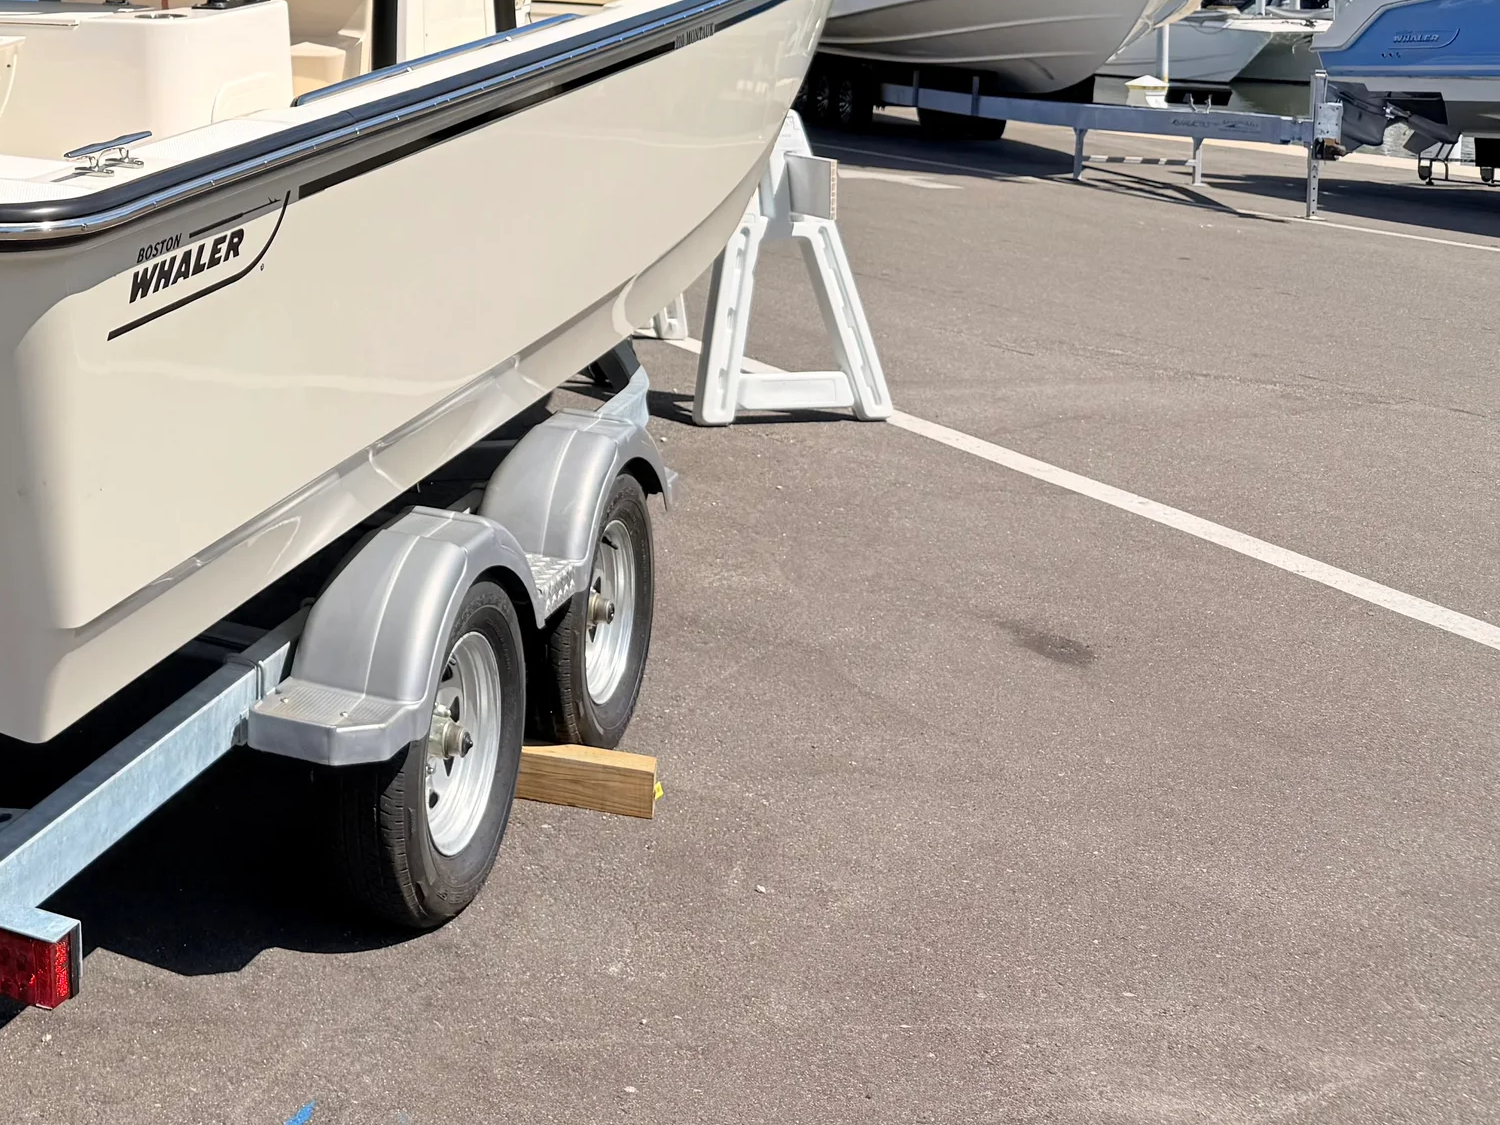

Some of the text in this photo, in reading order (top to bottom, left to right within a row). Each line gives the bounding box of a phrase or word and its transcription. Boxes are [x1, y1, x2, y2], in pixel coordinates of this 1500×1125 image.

[1393, 34, 1440, 44] WHALER
[136, 233, 182, 263] BOSTON
[129, 228, 244, 304] WHALER
